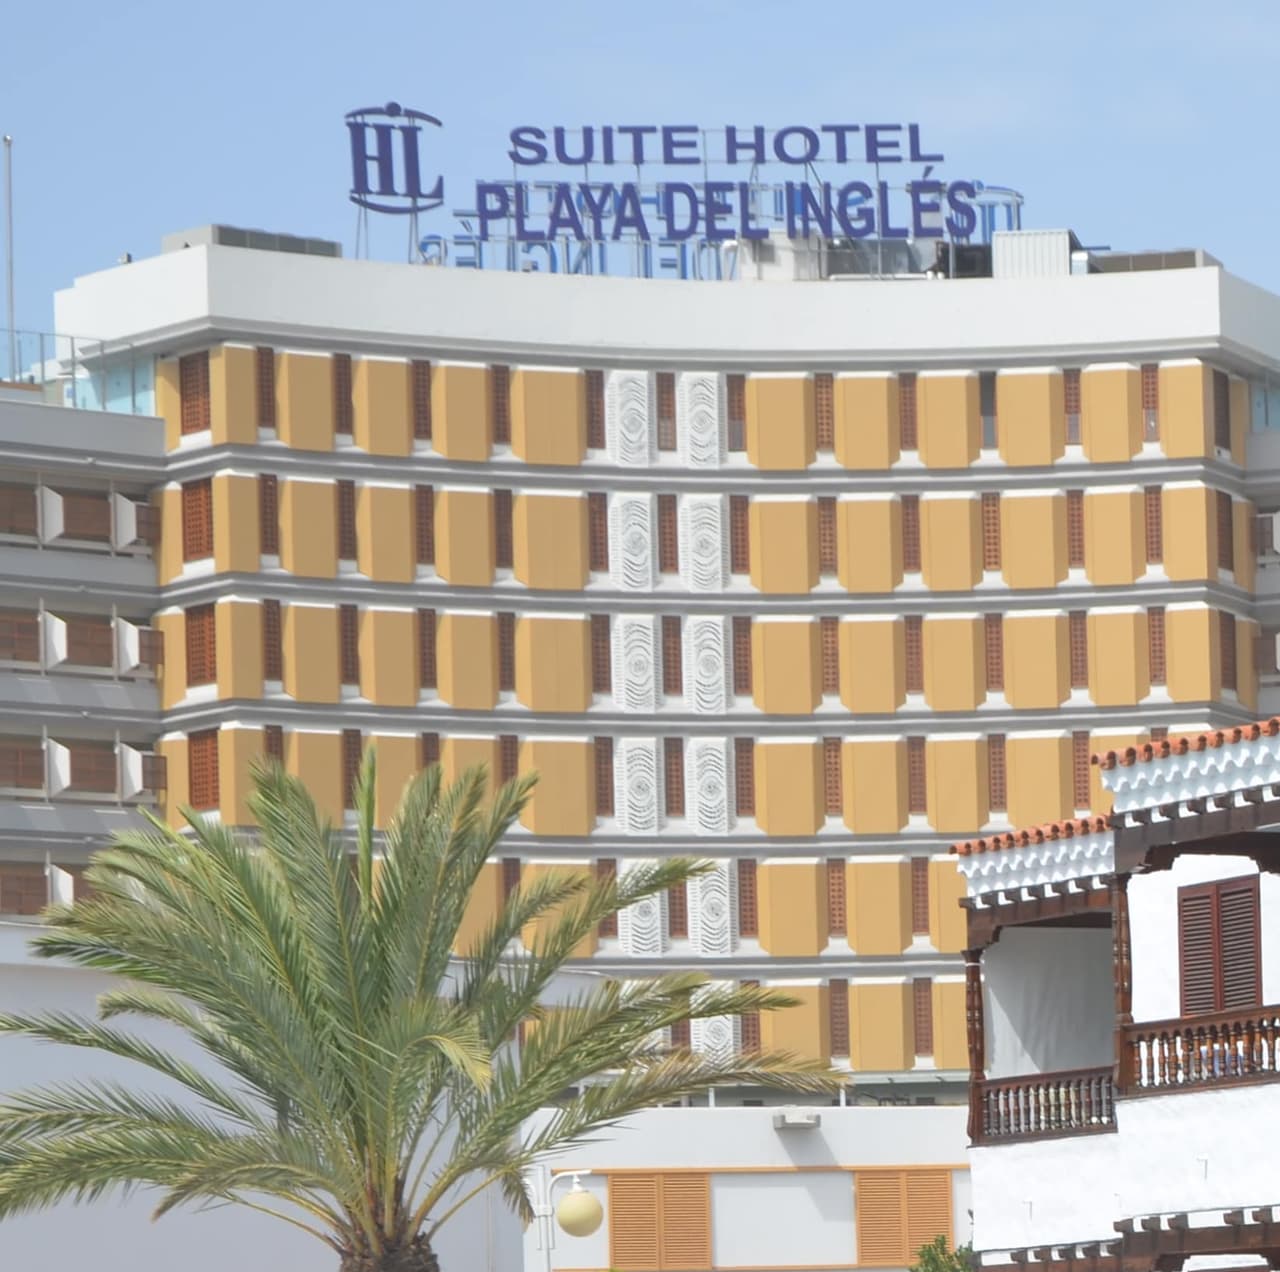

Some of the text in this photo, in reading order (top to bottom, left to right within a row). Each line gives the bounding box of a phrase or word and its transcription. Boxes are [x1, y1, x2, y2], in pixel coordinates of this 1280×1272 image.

[507, 123, 945, 165] SUITE HOTEL
[475, 182, 651, 241] PLAYA
[663, 181, 769, 240] DEL
[785, 165, 977, 240] INGLÉS
